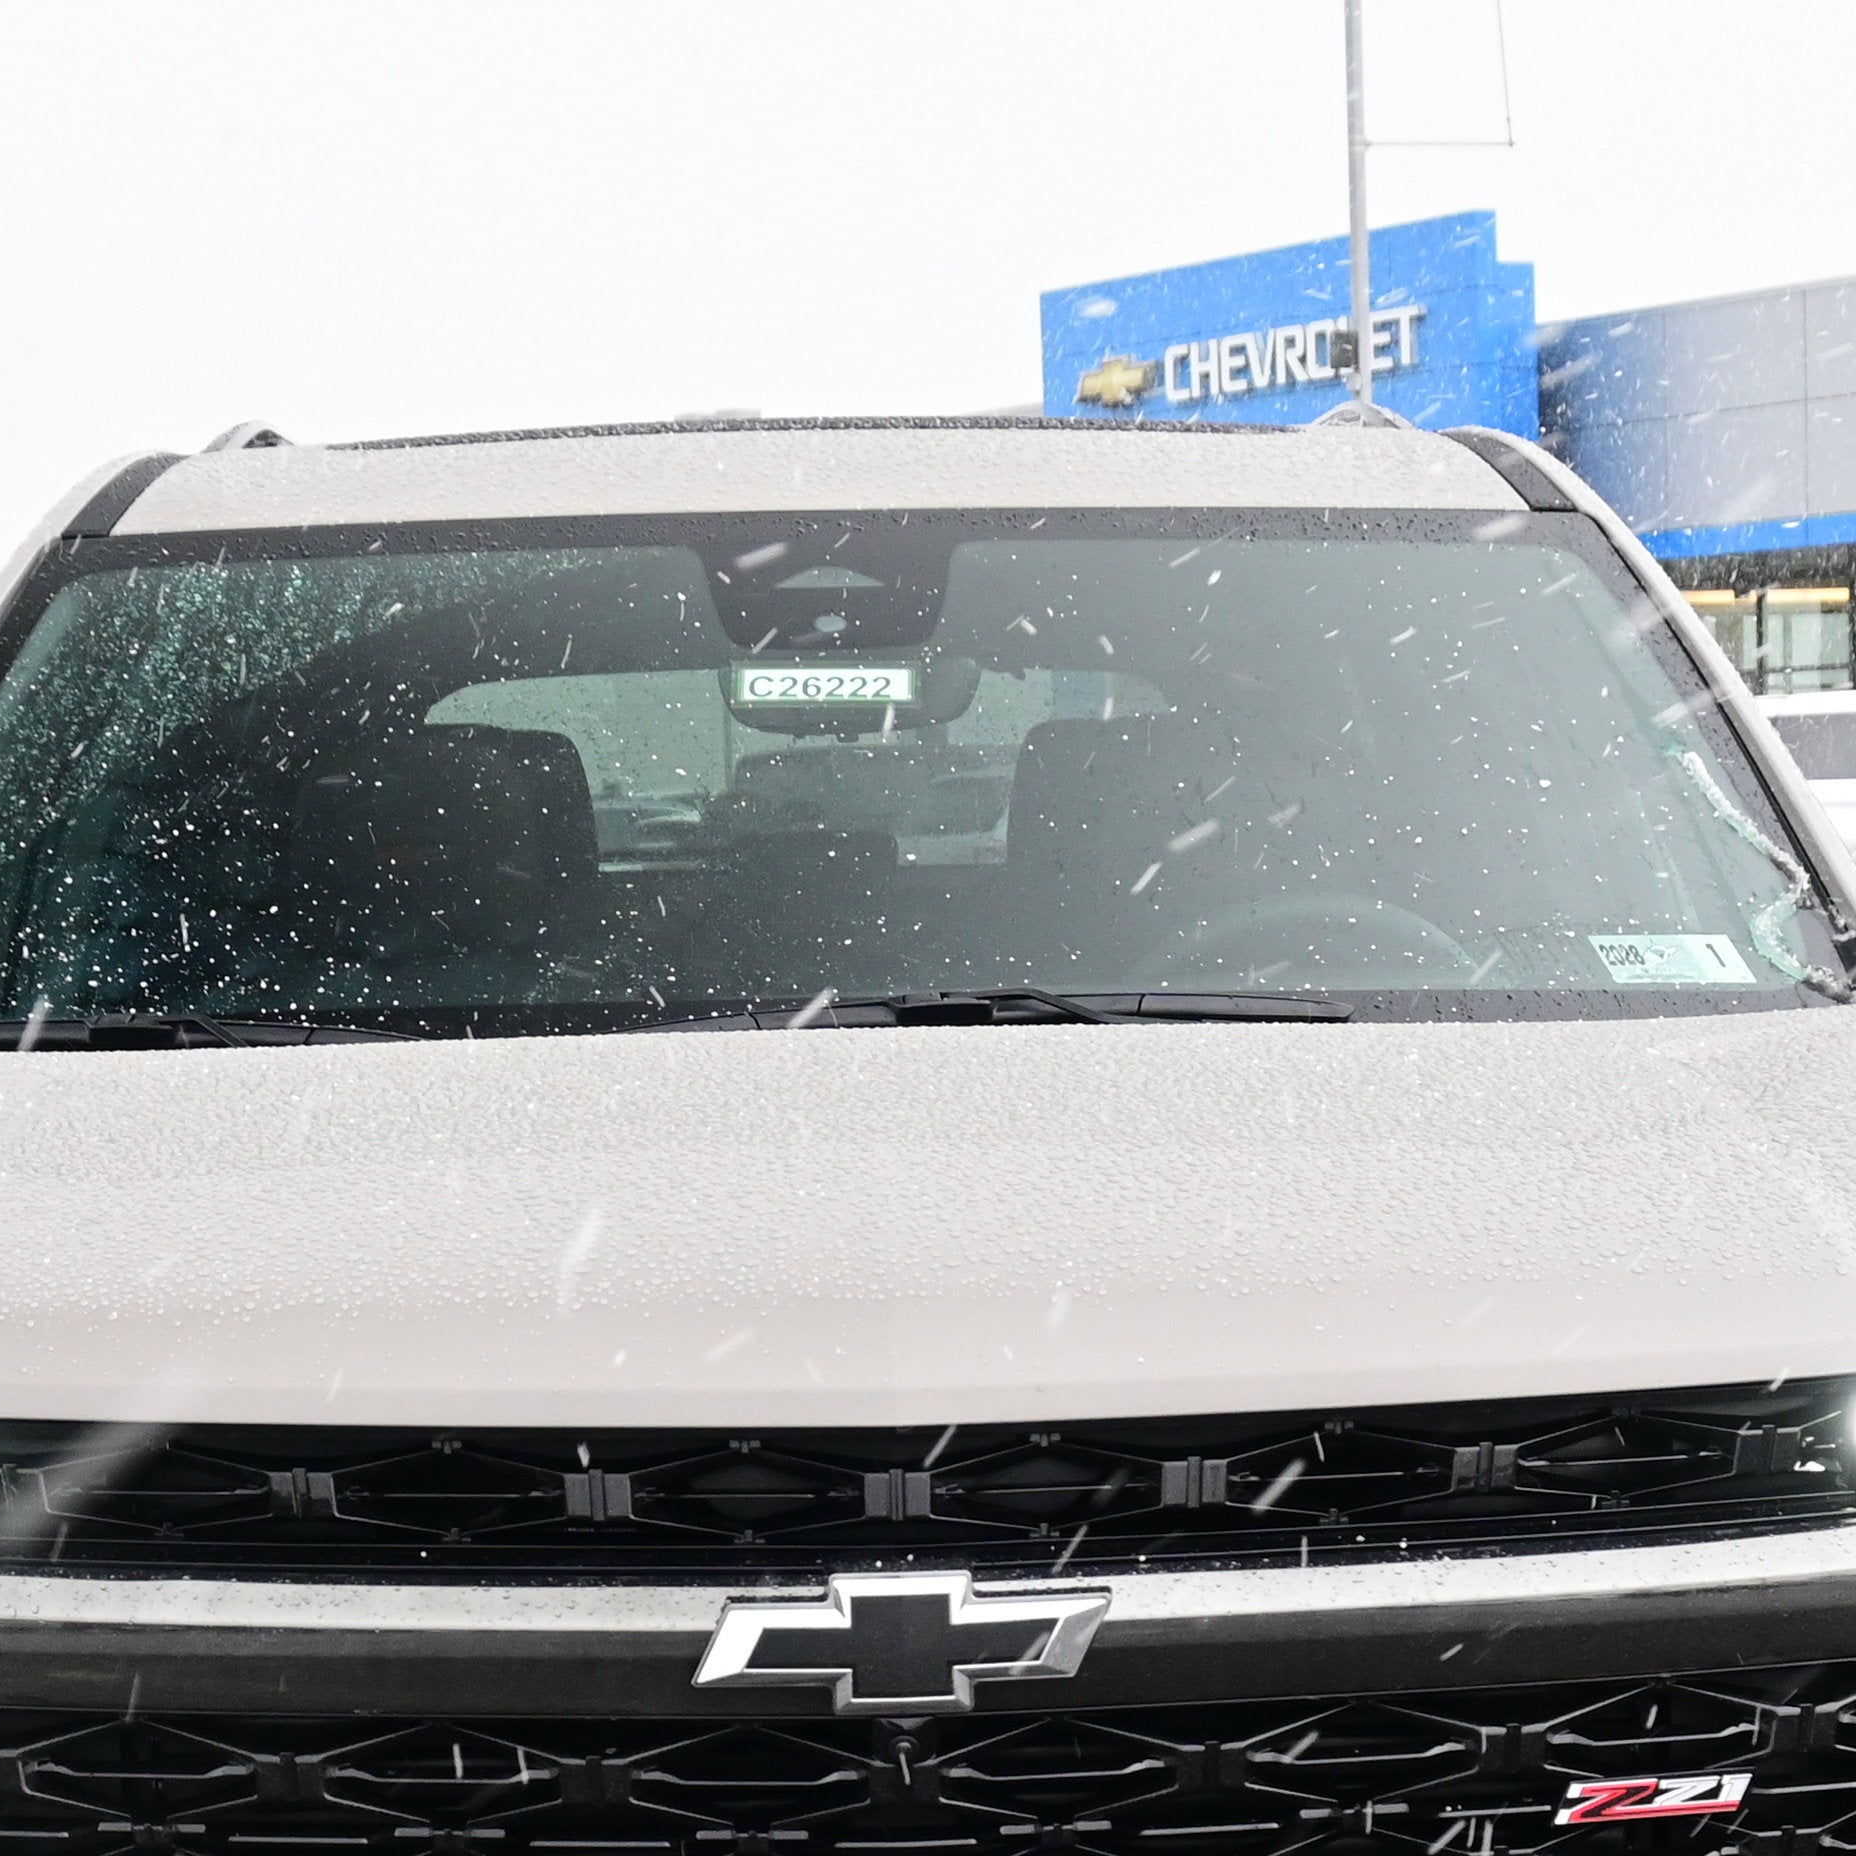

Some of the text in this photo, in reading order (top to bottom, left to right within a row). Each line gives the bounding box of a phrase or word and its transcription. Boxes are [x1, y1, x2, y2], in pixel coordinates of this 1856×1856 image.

[748, 675, 892, 698] C26222
[1598, 942, 1727, 968] 2028 1
[1553, 1772, 1754, 1826] Z71
